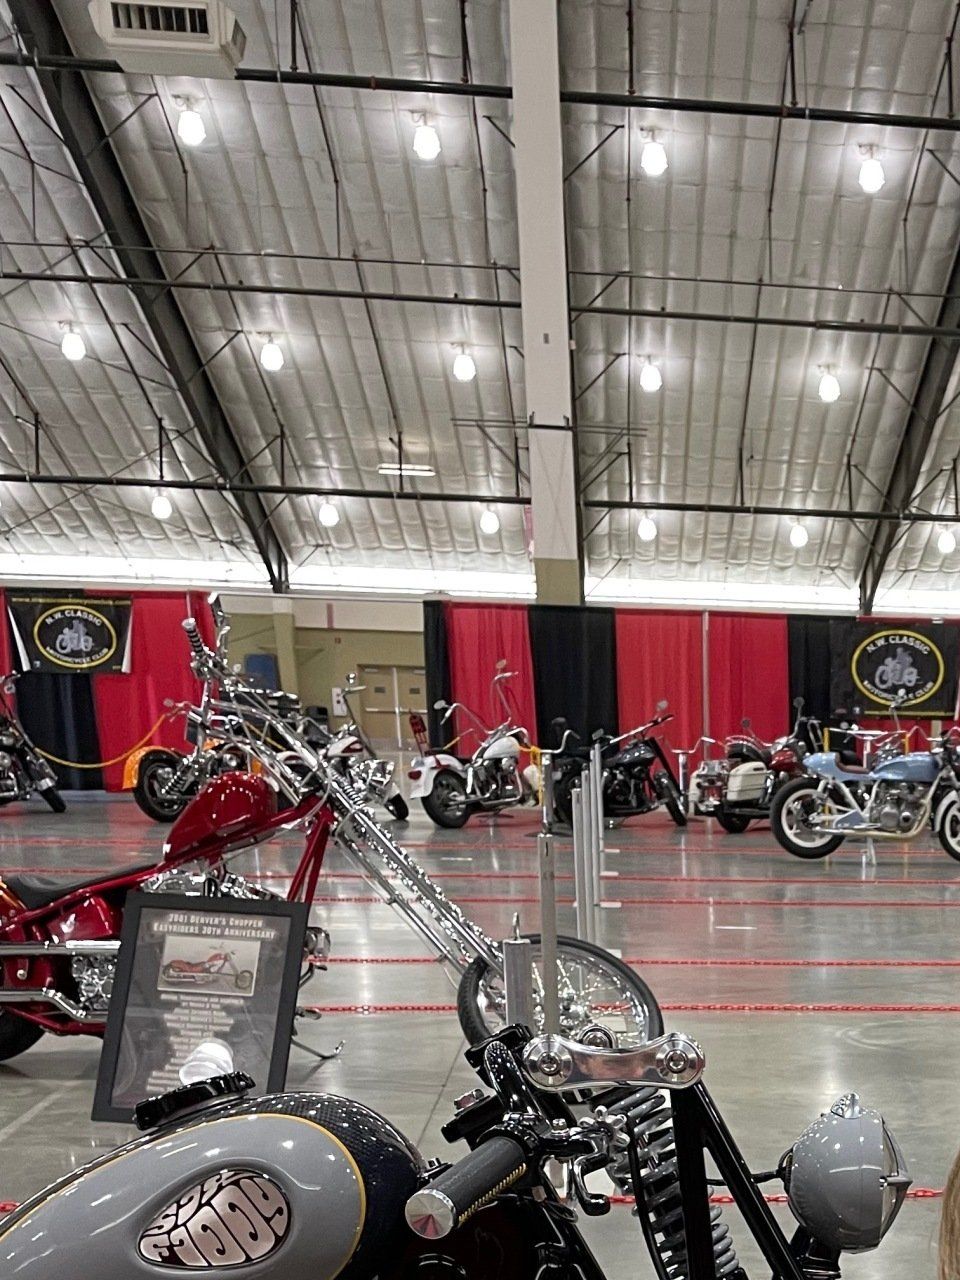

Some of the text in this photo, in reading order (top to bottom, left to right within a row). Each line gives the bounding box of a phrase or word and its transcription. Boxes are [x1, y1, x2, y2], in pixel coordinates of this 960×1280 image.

[65, 610, 102, 625] CLASSIC
[866, 636, 930, 654] N.W. CLASSIC
[46, 647, 109, 663] MOTORCYCLE CLUB
[915, 681, 934, 698] CLUB
[224, 928, 276, 938] ANNIVERSARY
